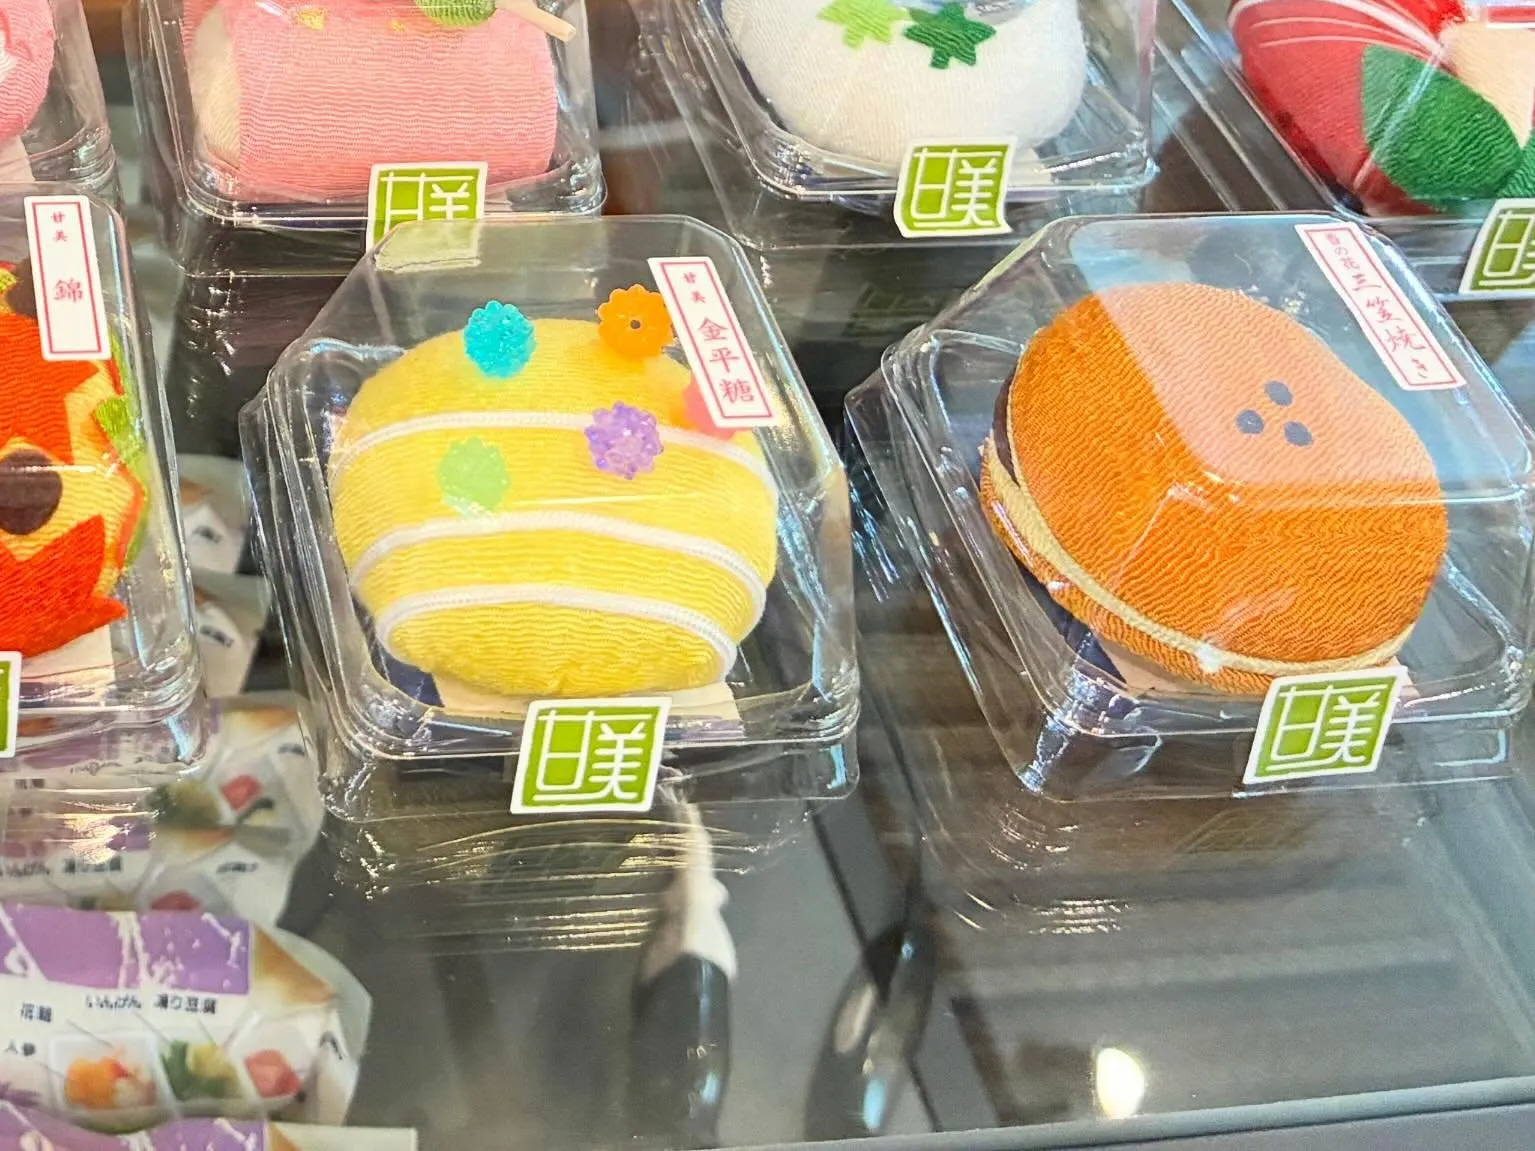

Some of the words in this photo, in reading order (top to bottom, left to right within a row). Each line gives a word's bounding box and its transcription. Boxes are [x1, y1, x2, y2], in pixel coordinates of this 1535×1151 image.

[54, 278, 84, 303] 錦
[698, 316, 755, 404] 金平糖
